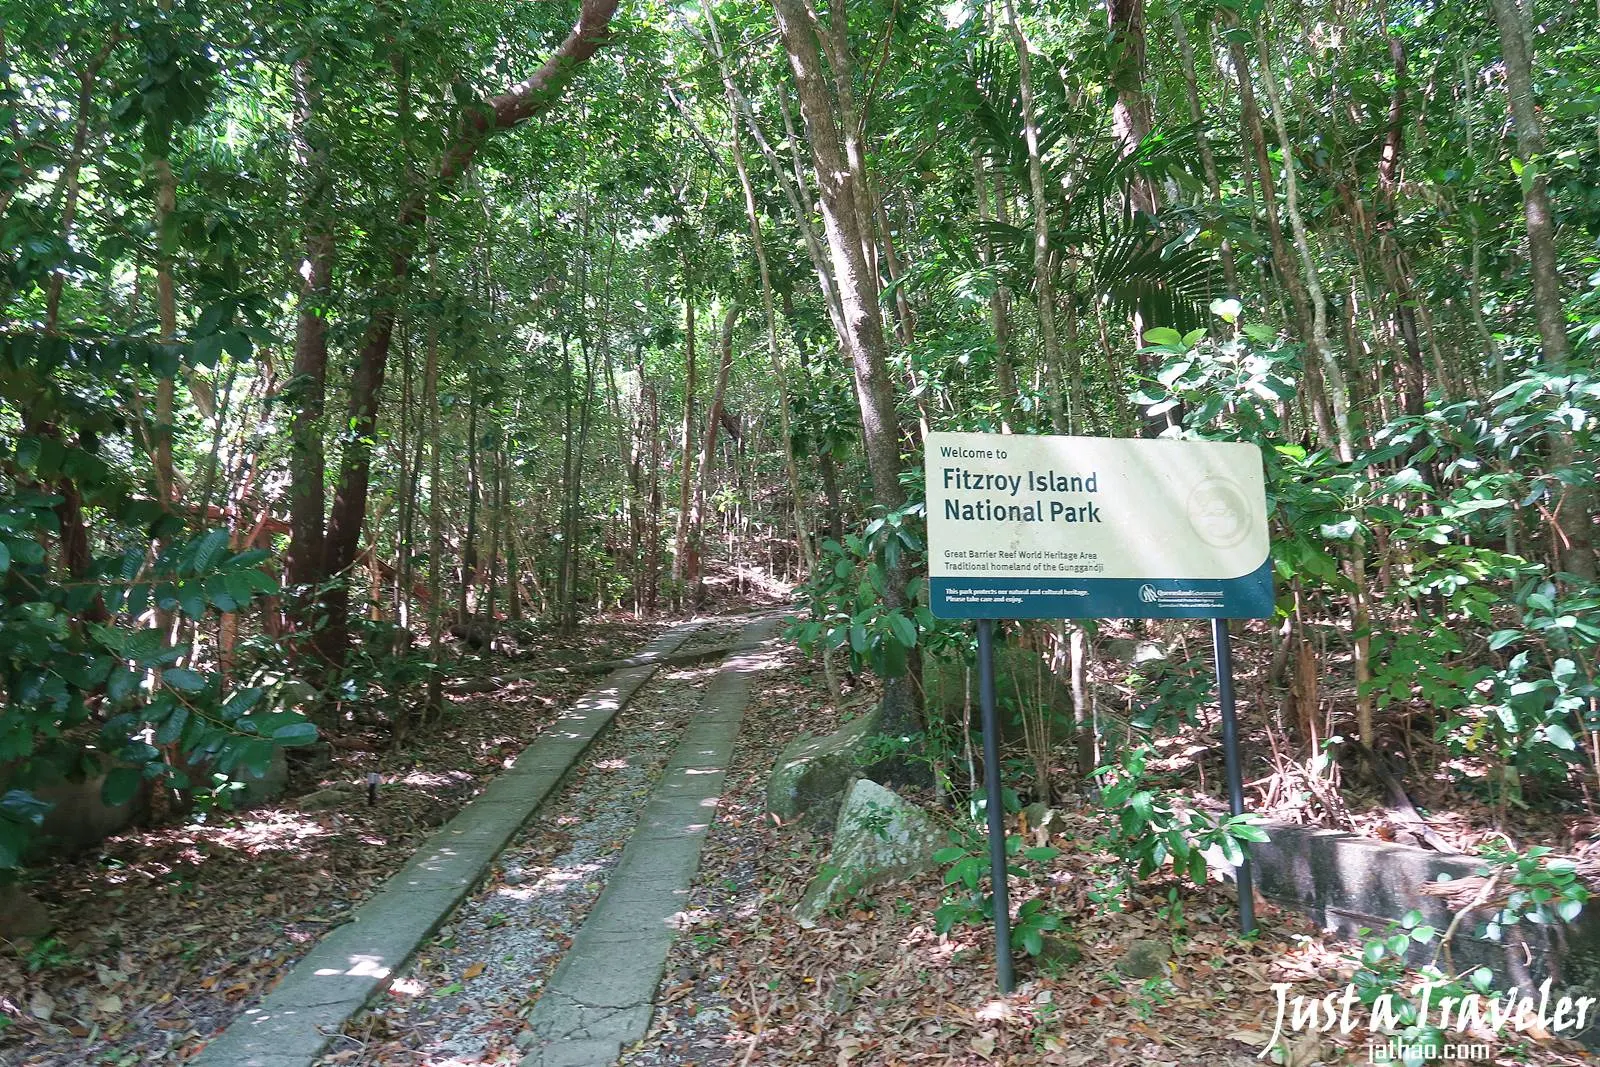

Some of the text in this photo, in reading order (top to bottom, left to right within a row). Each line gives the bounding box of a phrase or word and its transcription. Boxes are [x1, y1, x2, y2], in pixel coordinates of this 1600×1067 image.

[940, 446, 1008, 460] Welcome to
[943, 467, 1098, 496] Fitzroy Island
[945, 499, 1102, 523] National Park
[944, 549, 1098, 561] Great Barrier Reef World Heritage Area
[944, 562, 1104, 573] Traditional homeland of the Gunggandji
[959, 588, 973, 596] park
